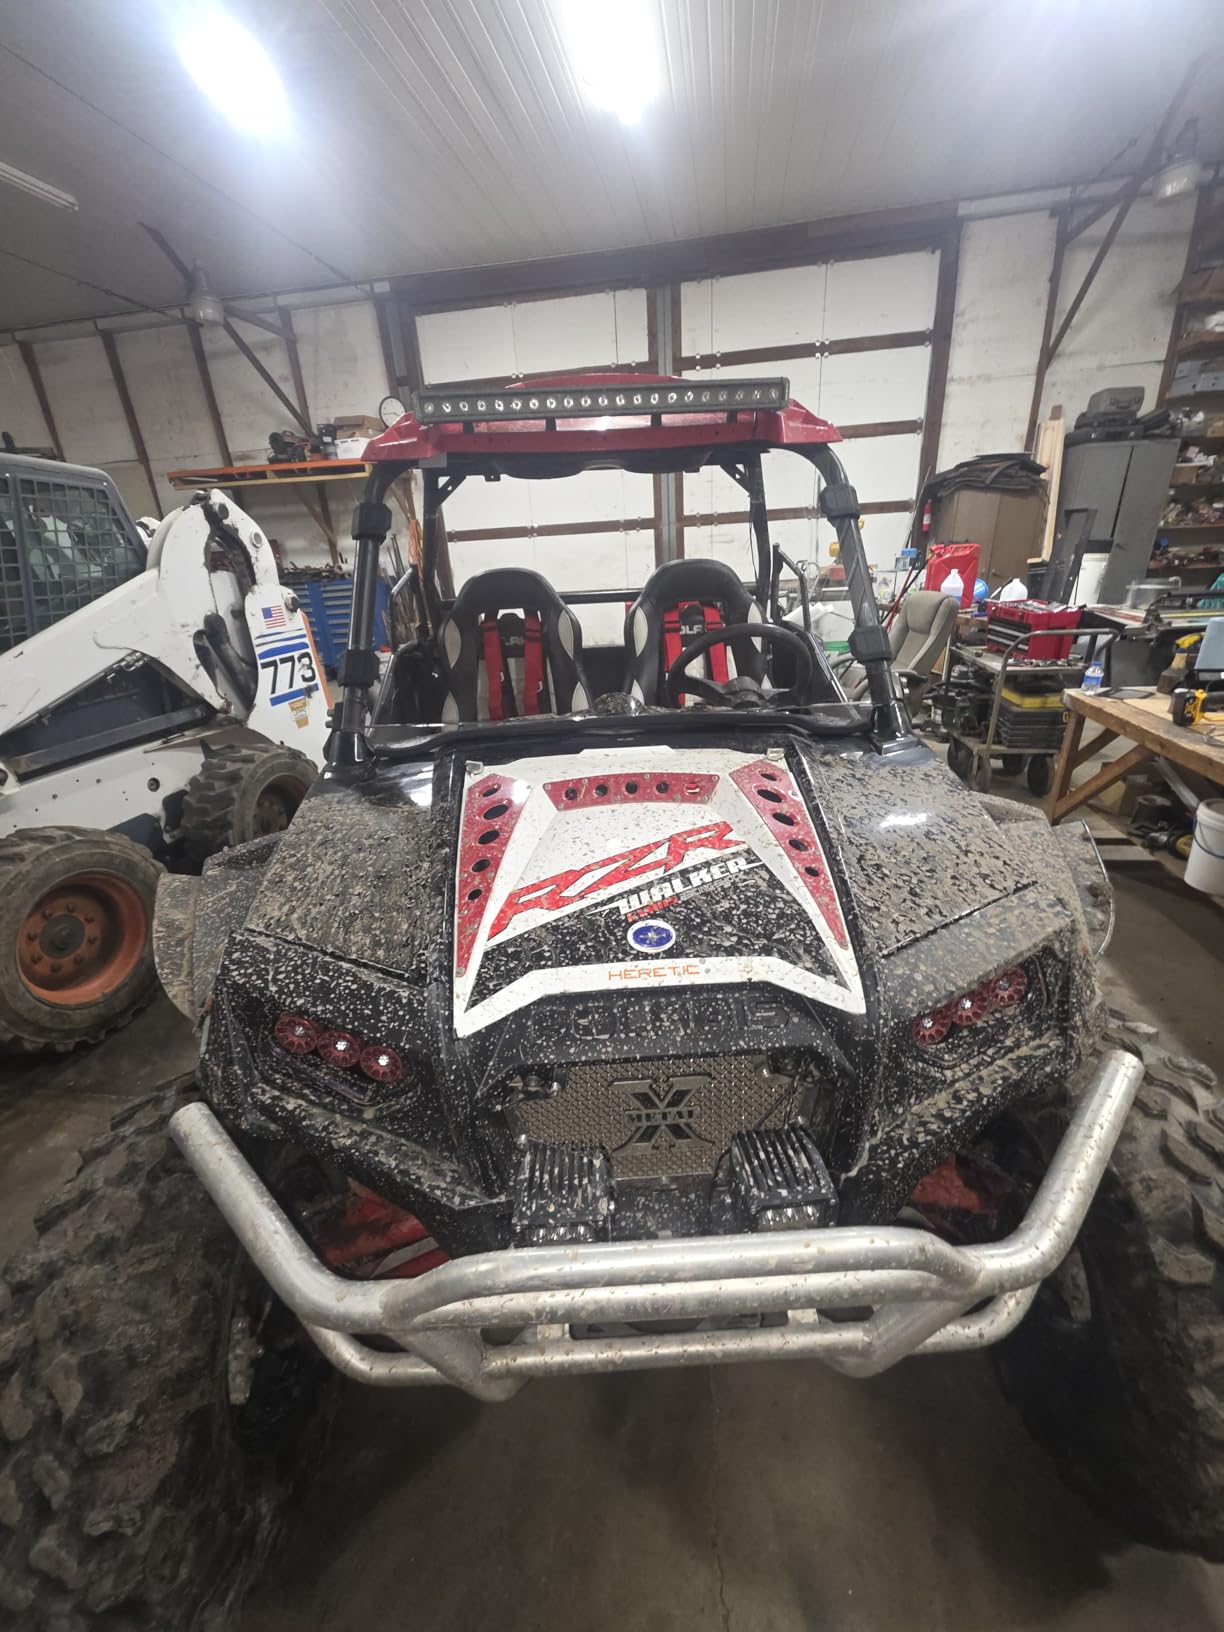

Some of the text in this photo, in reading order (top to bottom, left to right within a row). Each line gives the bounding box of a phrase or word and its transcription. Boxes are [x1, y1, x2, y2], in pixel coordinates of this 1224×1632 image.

[260, 651, 317, 695] 773
[487, 820, 748, 941] RZR
[616, 856, 750, 915] WALKER
[608, 964, 701, 981] HERETIC
